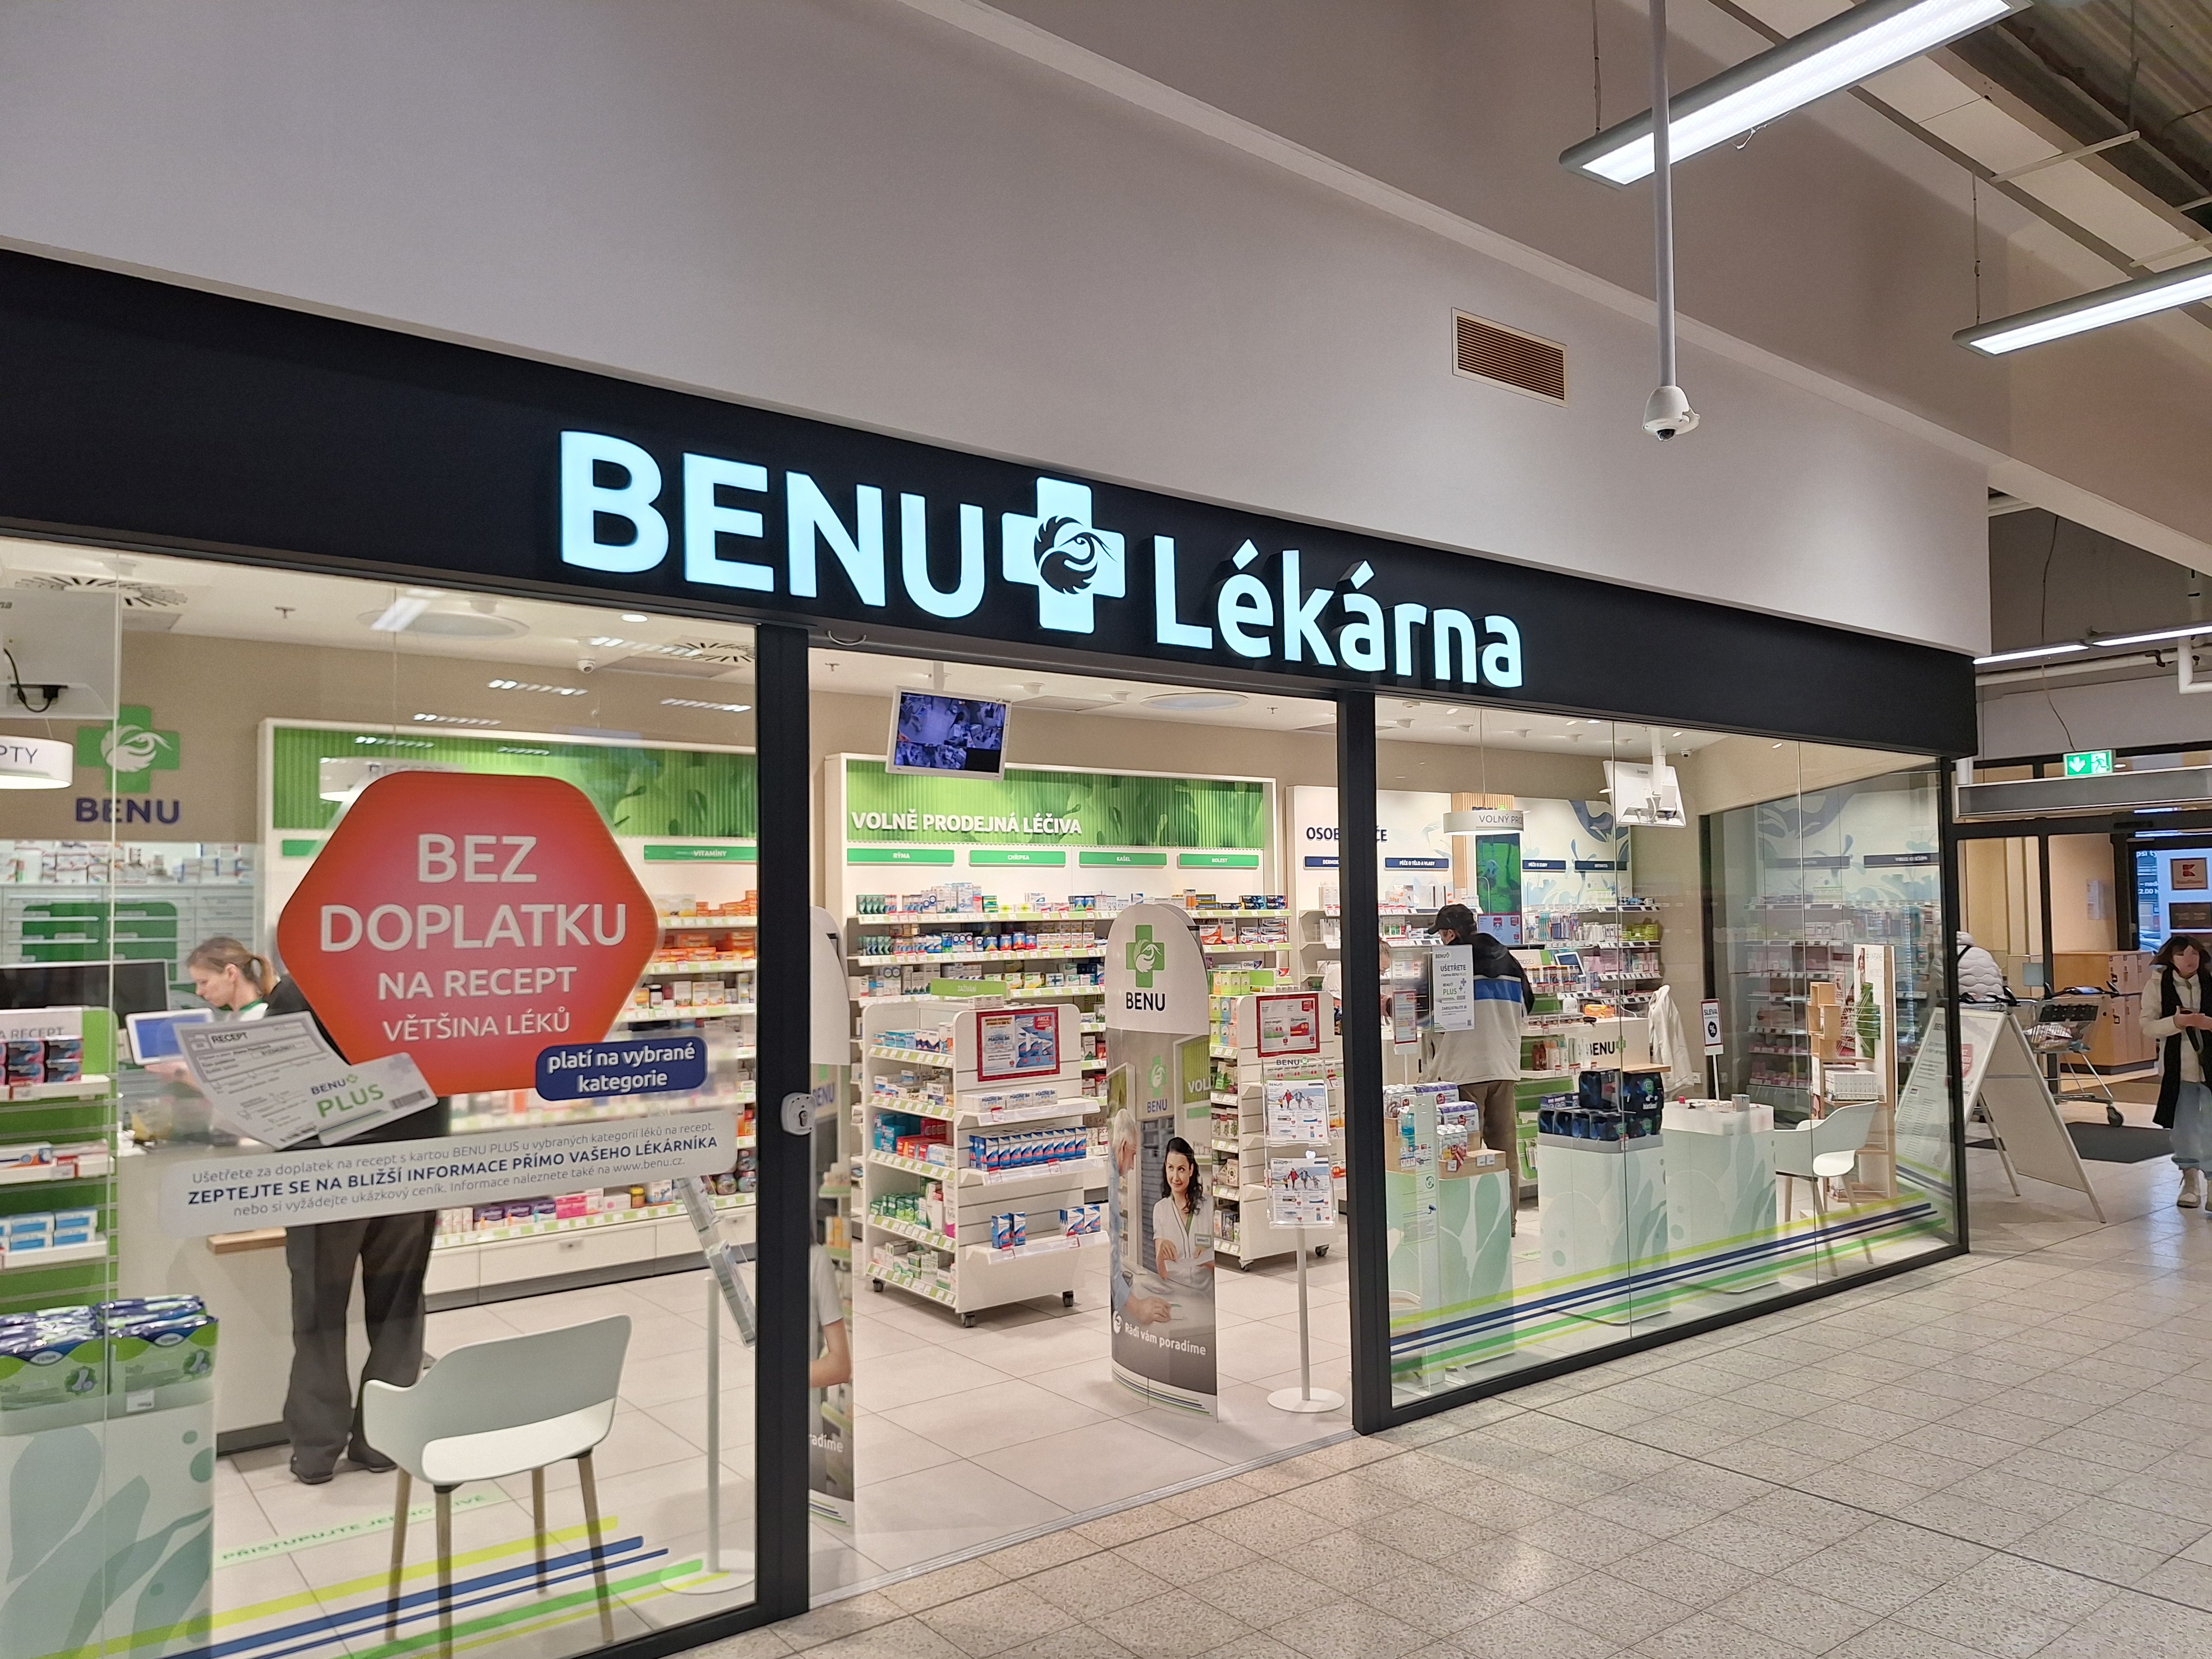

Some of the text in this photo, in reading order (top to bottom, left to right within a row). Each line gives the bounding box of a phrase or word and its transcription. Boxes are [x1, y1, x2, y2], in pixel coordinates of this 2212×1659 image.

[560, 430, 1523, 689] BENU Lékárna
[75, 798, 180, 824] BENU
[852, 809, 1083, 834] VOLNĚ PRODEJNÁ LÉČIVA
[1479, 814, 1509, 823] VOLNÝ
[417, 833, 538, 884] BEZ
[693, 849, 728, 857] VITAMÍNY
[319, 903, 627, 953] DOPLATKU
[378, 966, 578, 1001] NA RECEPT
[1440, 963, 1467, 972] UŠETŘETE
[1126, 992, 1166, 1012] BENU
[382, 1006, 571, 1043] VĚTŠINA LÉKŮ
[547, 1036, 696, 1072] platí na vybrané
[311, 1079, 347, 1095] BENU
[578, 1069, 668, 1095] kategorie
[316, 1084, 385, 1118] PLUS
[1147, 1098, 1168, 1113] BENU
[192, 1121, 715, 1184] Ušetřete za doplatek na recept s kartou BENU PLUS u vybraných kategorií léků na recept.
[188, 1136, 718, 1205] ZEPTEJTE SE NA BLIŽŠÍ INFORMACE PŘÍMO VAŠEHO LÉKÁRNÍKA
[234, 1157, 686, 1217] nebo si vyžádejte ukázkový ceník. Informace naleznete také na www.benu.cz.
[1124, 1322, 1207, 1356] Rádi vám poradíme
